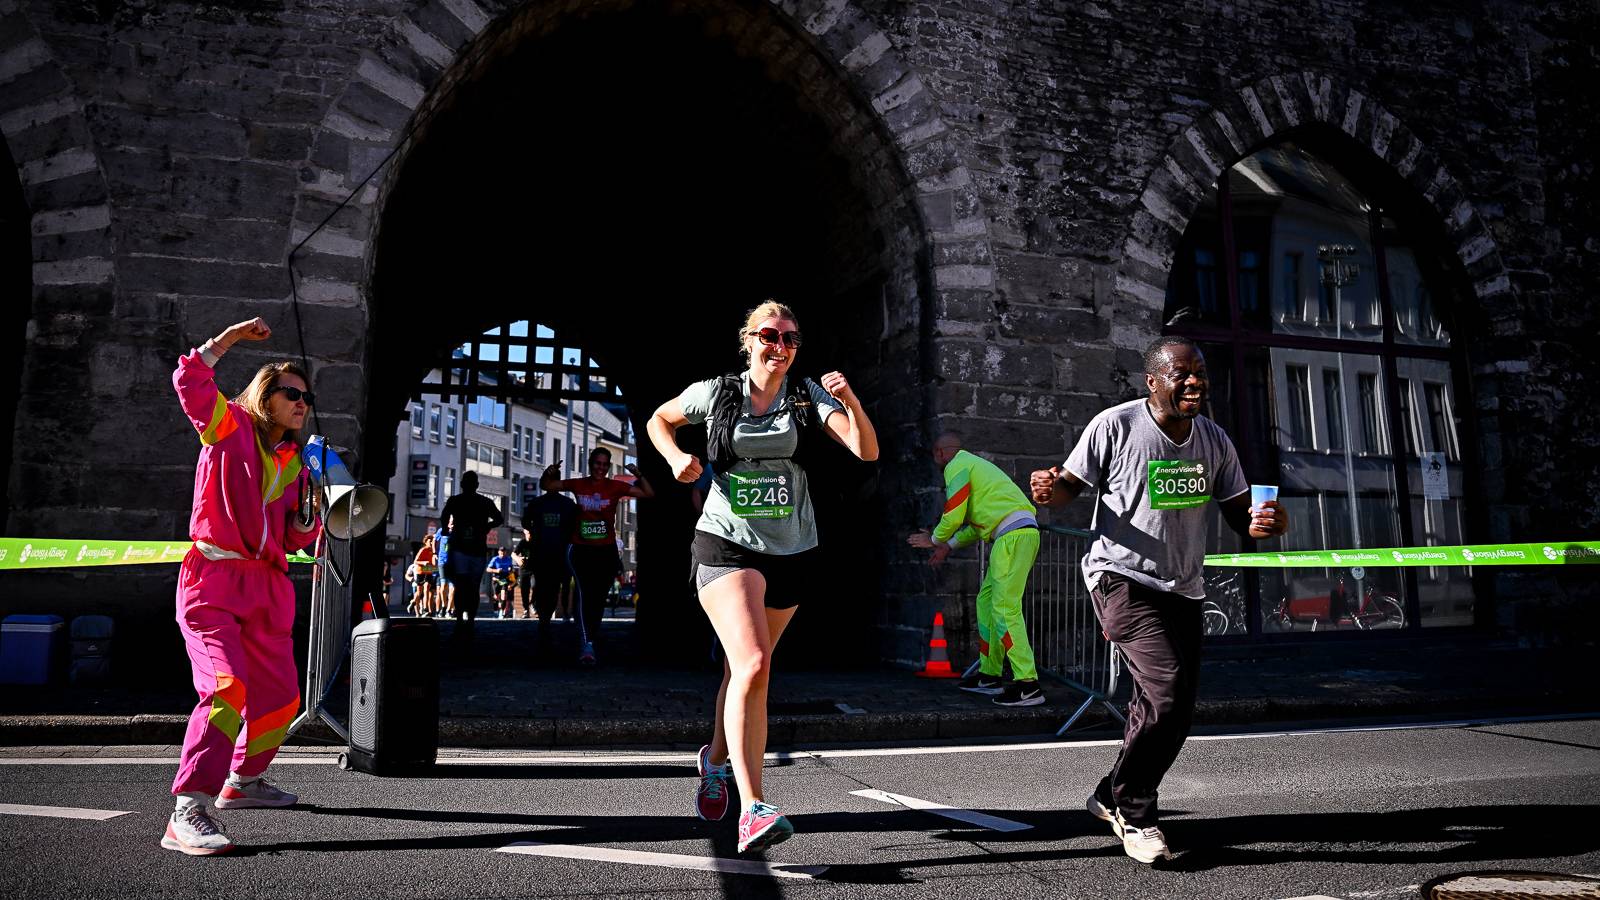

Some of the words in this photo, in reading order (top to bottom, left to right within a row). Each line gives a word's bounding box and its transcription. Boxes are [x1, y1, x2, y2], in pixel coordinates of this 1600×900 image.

[1157, 466, 1197, 474] EnergyVision
[738, 477, 777, 485] EnergyVision
[1155, 477, 1206, 495] 30590
[737, 487, 788, 506] 5246
[582, 525, 607, 534] 30425
[29, 546, 68, 561] EnergyVision
[1339, 552, 1381, 562] EnergyVision
[1402, 550, 1447, 561] EnergyVision
[1474, 549, 1526, 560] EnergyVision
